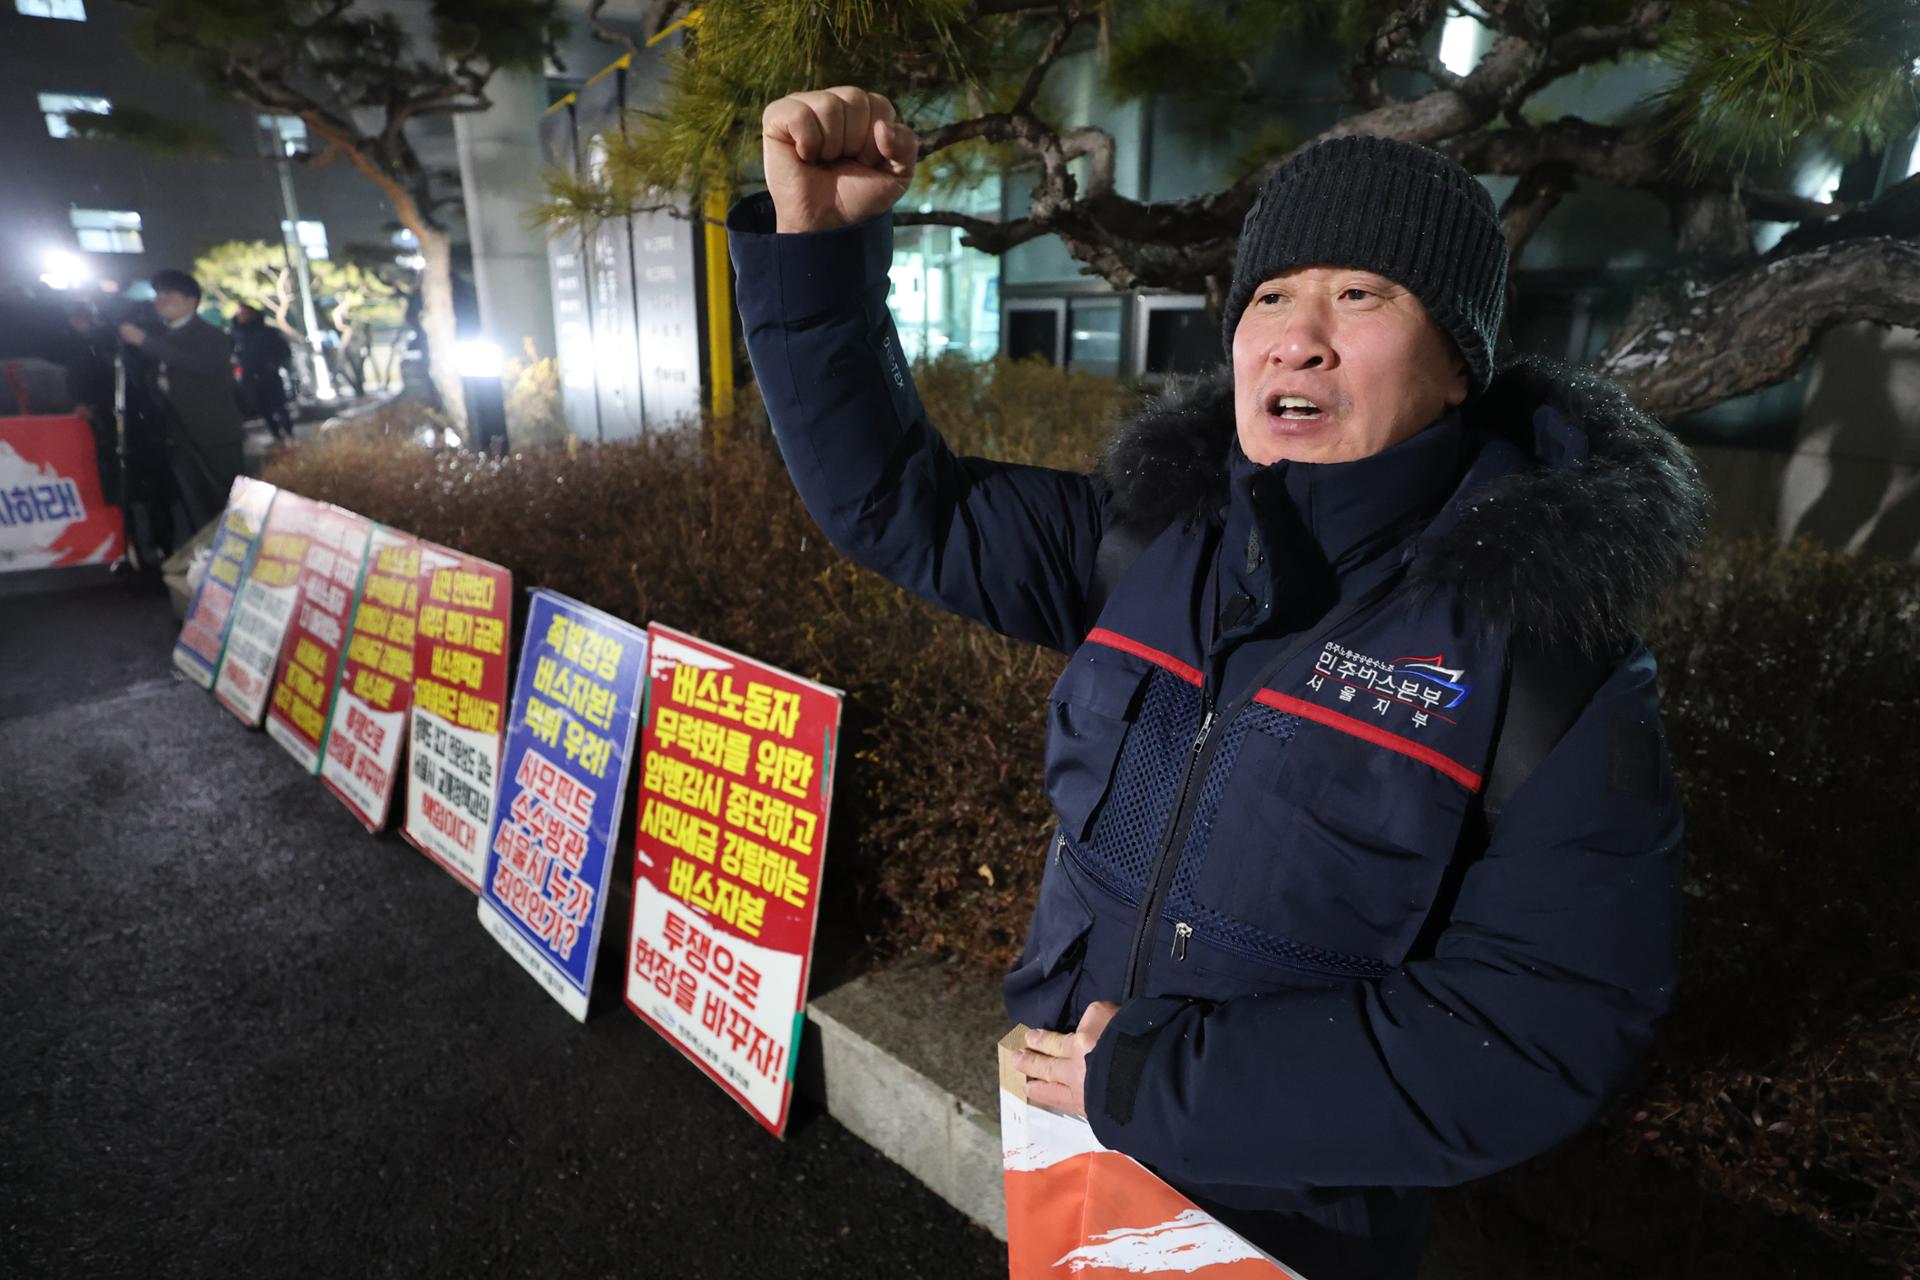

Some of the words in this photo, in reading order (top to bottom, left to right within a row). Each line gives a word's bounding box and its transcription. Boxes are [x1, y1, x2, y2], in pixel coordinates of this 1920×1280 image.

[546, 613, 622, 683] 족벌경영
[1315, 651, 1443, 710] 민주버스본부
[533, 655, 617, 731] 버스자본!
[671, 663, 801, 740] 버스노동자
[525, 695, 564, 749] 먹튀
[563, 721, 611, 779] 우려!
[654, 707, 752, 777] 무력화를
[755, 740, 815, 800] 위한
[517, 753, 593, 827] 사모펀드
[643, 750, 725, 818] 암행감시
[725, 781, 817, 856] 중단하고
[496, 822, 550, 886] 서울시
[550, 864, 591, 920] 누가
[512, 797, 586, 870] 수수방관
[640, 798, 720, 865] 시민세금
[721, 830, 810, 909] 강탈하는
[494, 866, 577, 955] 죄인인가?
[667, 856, 767, 938] 버스자본
[662, 910, 763, 1013] 투쟁으로
[634, 937, 698, 1016] 현장을
[702, 989, 784, 1085] 바꾸자!
